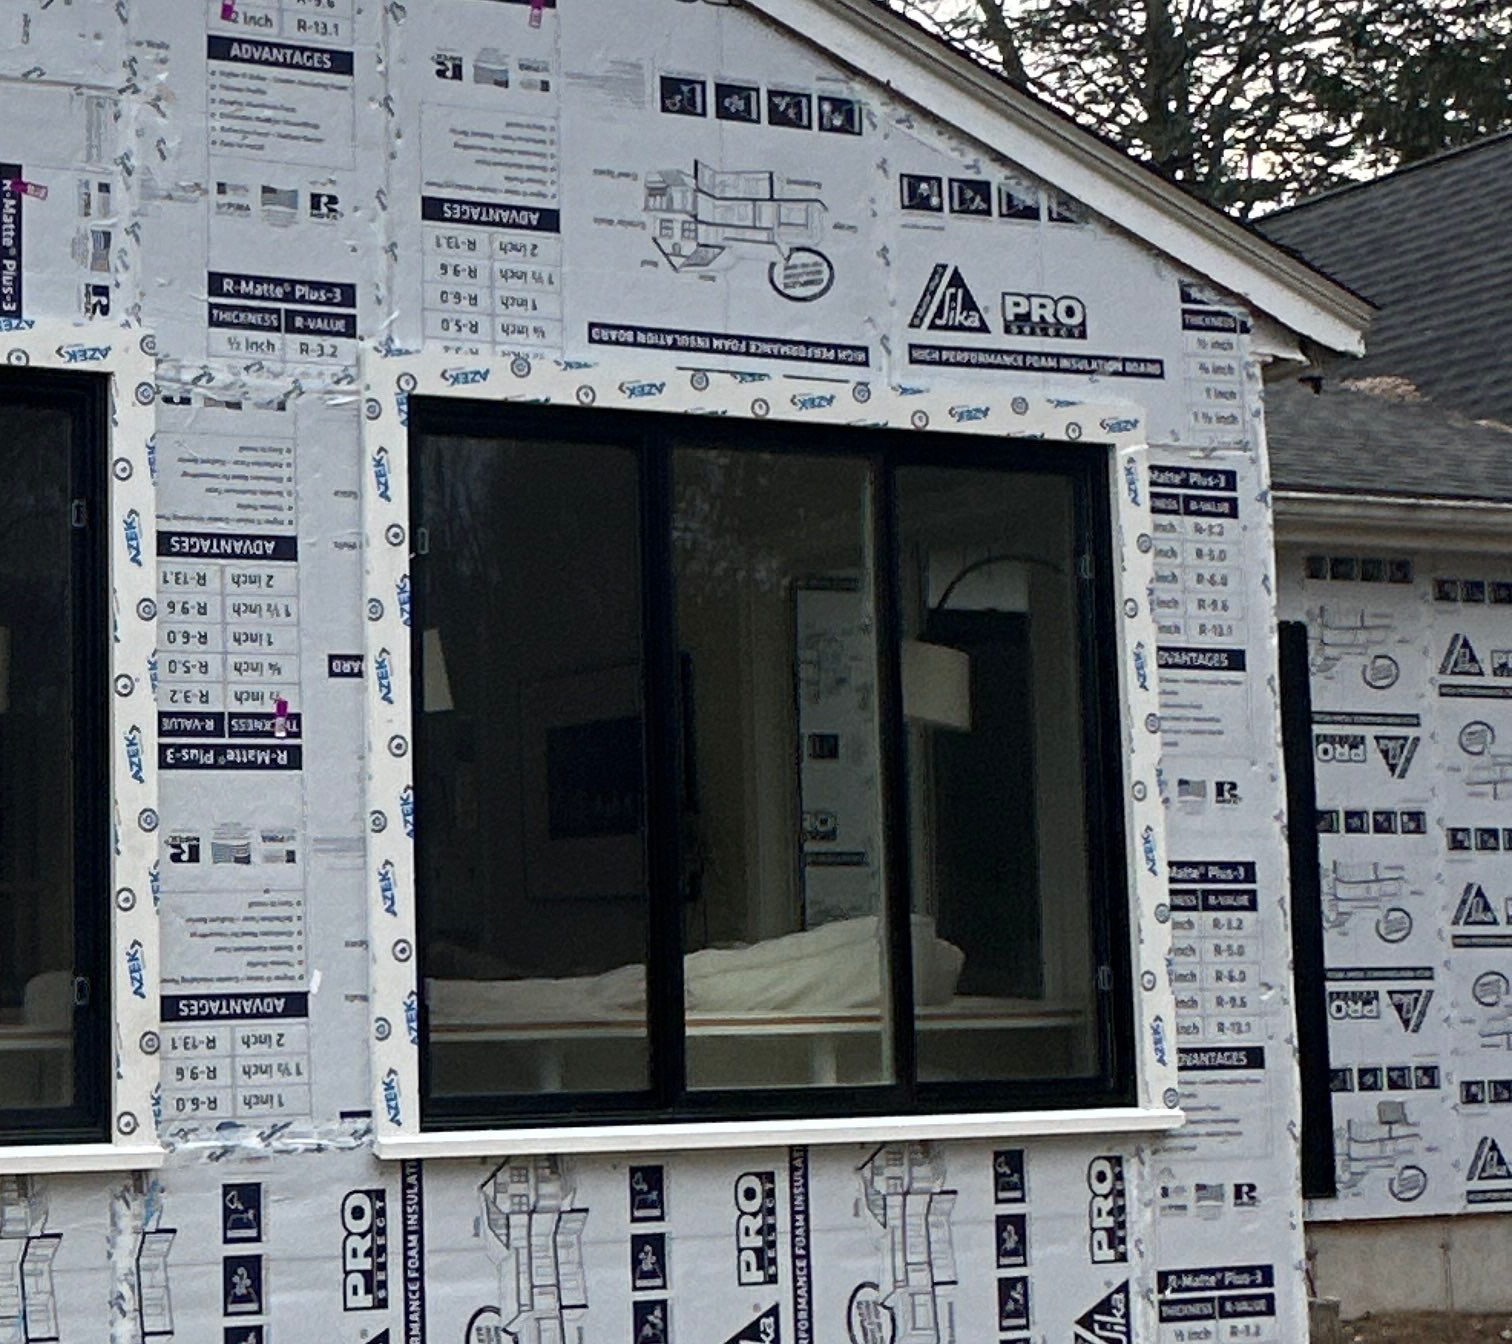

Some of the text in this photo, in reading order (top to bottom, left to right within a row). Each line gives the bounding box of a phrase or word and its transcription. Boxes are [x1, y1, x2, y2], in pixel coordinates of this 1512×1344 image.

[243, 11, 273, 29] inch
[229, 42, 332, 69] ADVANTAGES
[443, 202, 540, 225] ADVANTAGES
[2, 258, 18, 313] Plus-3
[295, 285, 342, 303] Plus-3
[935, 287, 981, 327] Sika
[1004, 293, 1086, 328] PRO
[213, 308, 346, 332] THICKNESS R-VALUE
[66, 344, 112, 363] AZEK
[244, 339, 338, 357] inch R-3.2
[123, 517, 142, 567] AZEK
[170, 535, 275, 555] ADVANTAGES
[161, 570, 207, 586] R-13.1
[231, 571, 263, 588] inch
[166, 600, 208, 616] R-9.6
[232, 601, 263, 617] inch
[166, 629, 208, 645] R-6.0
[232, 630, 262, 646] inch
[168, 659, 209, 675] R-5.0
[233, 659, 264, 675] inch
[375, 658, 394, 705] AZEK
[234, 689, 264, 705] inch
[123, 733, 145, 784] AZEK
[165, 748, 215, 765] Plus-3
[376, 867, 398, 918] AZEK
[125, 946, 146, 999] AZEK
[178, 997, 286, 1015] ADVANTAGES
[241, 1033, 273, 1049] inch
[242, 1063, 273, 1079] inch
[243, 1095, 274, 1110] inch
[382, 1077, 403, 1127] AZEK
[1089, 1157, 1116, 1261] PRO
[738, 1175, 765, 1283] PRO
[794, 1216, 808, 1255] FOAM
[345, 1192, 374, 1310] PRO
[407, 1235, 422, 1277] FOAM
